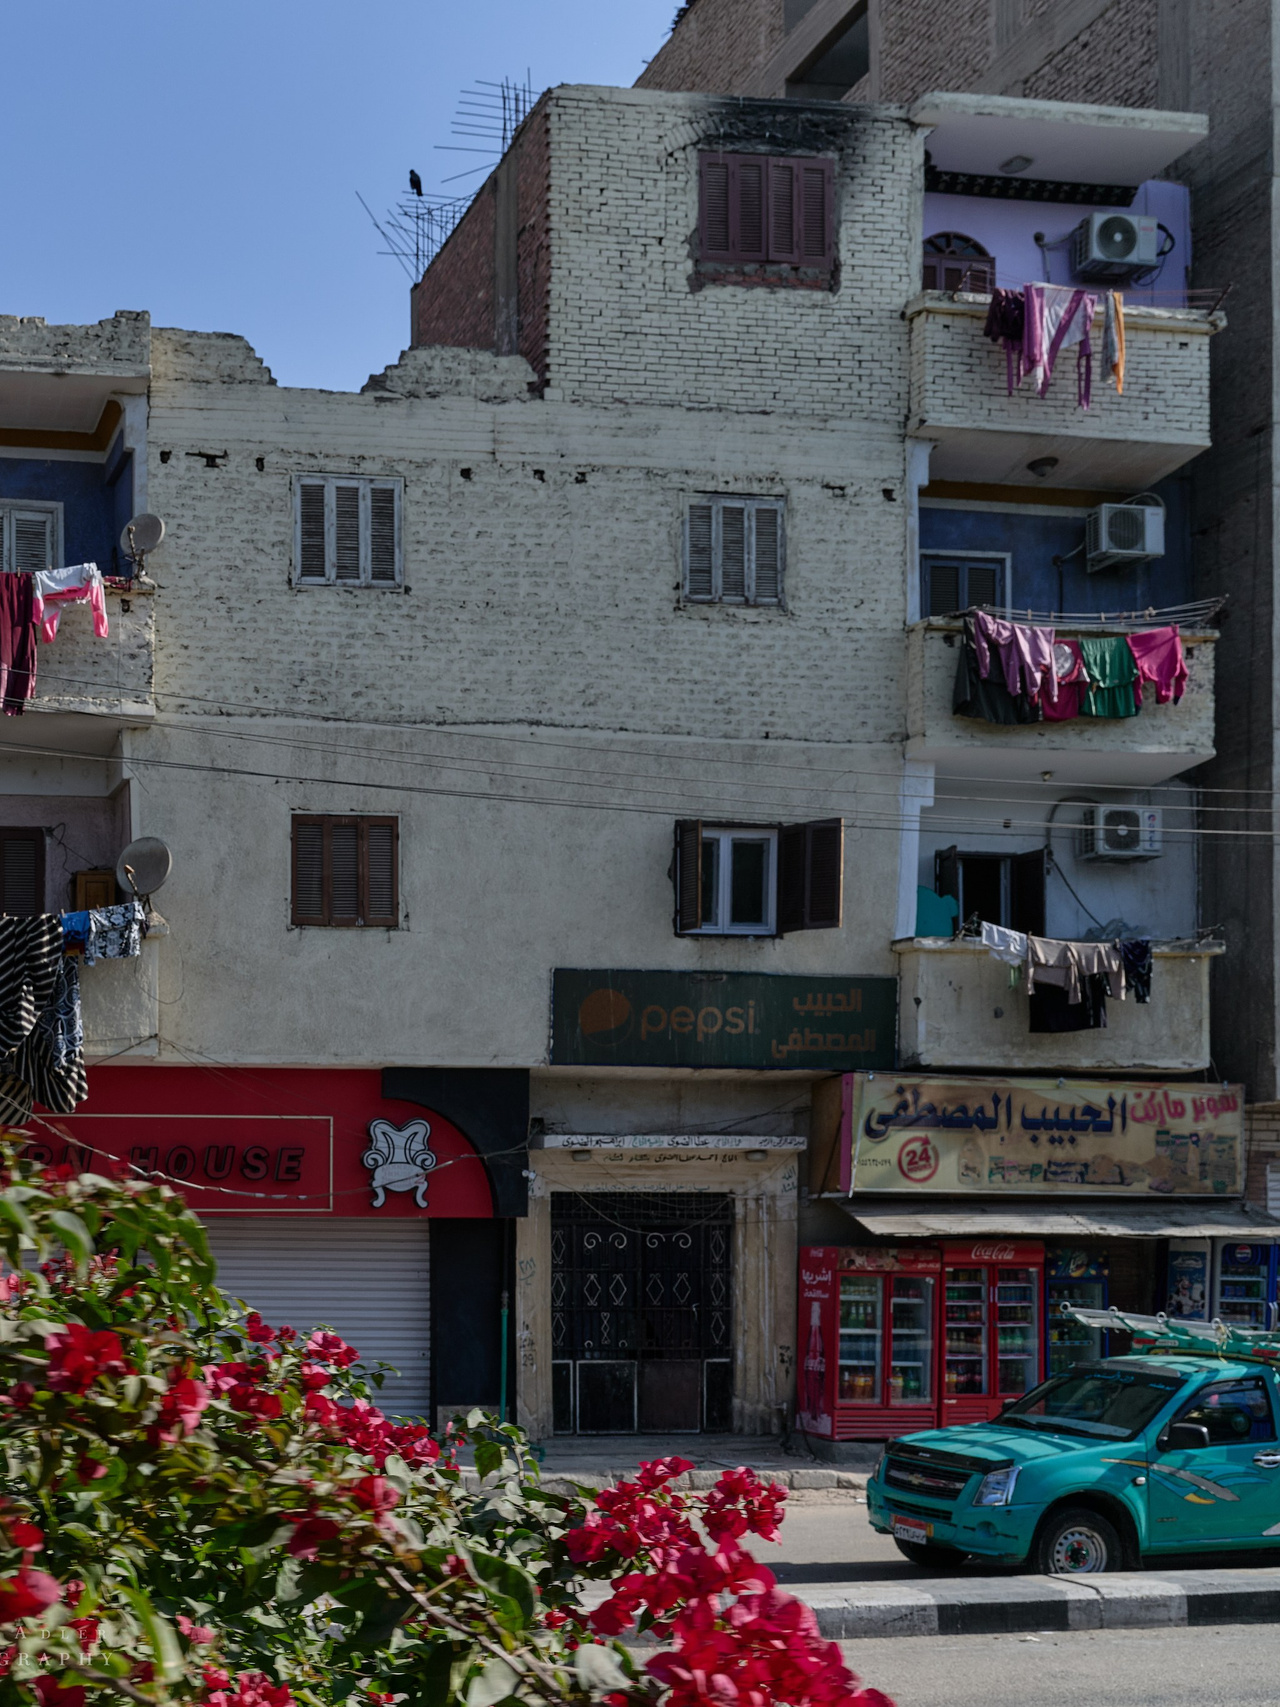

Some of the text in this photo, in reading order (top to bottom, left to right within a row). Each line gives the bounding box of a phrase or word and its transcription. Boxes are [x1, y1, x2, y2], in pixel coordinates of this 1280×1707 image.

[793, 988, 863, 1017] الحبيب
[640, 1001, 756, 1041] pepsi
[771, 1028, 877, 1060] المصطفى
[864, 1084, 1240, 1145] سوبر ماركت الحبيب المصطفى
[130, 1145, 306, 1182] HOUSE
[905, 1147, 931, 1166] 24
